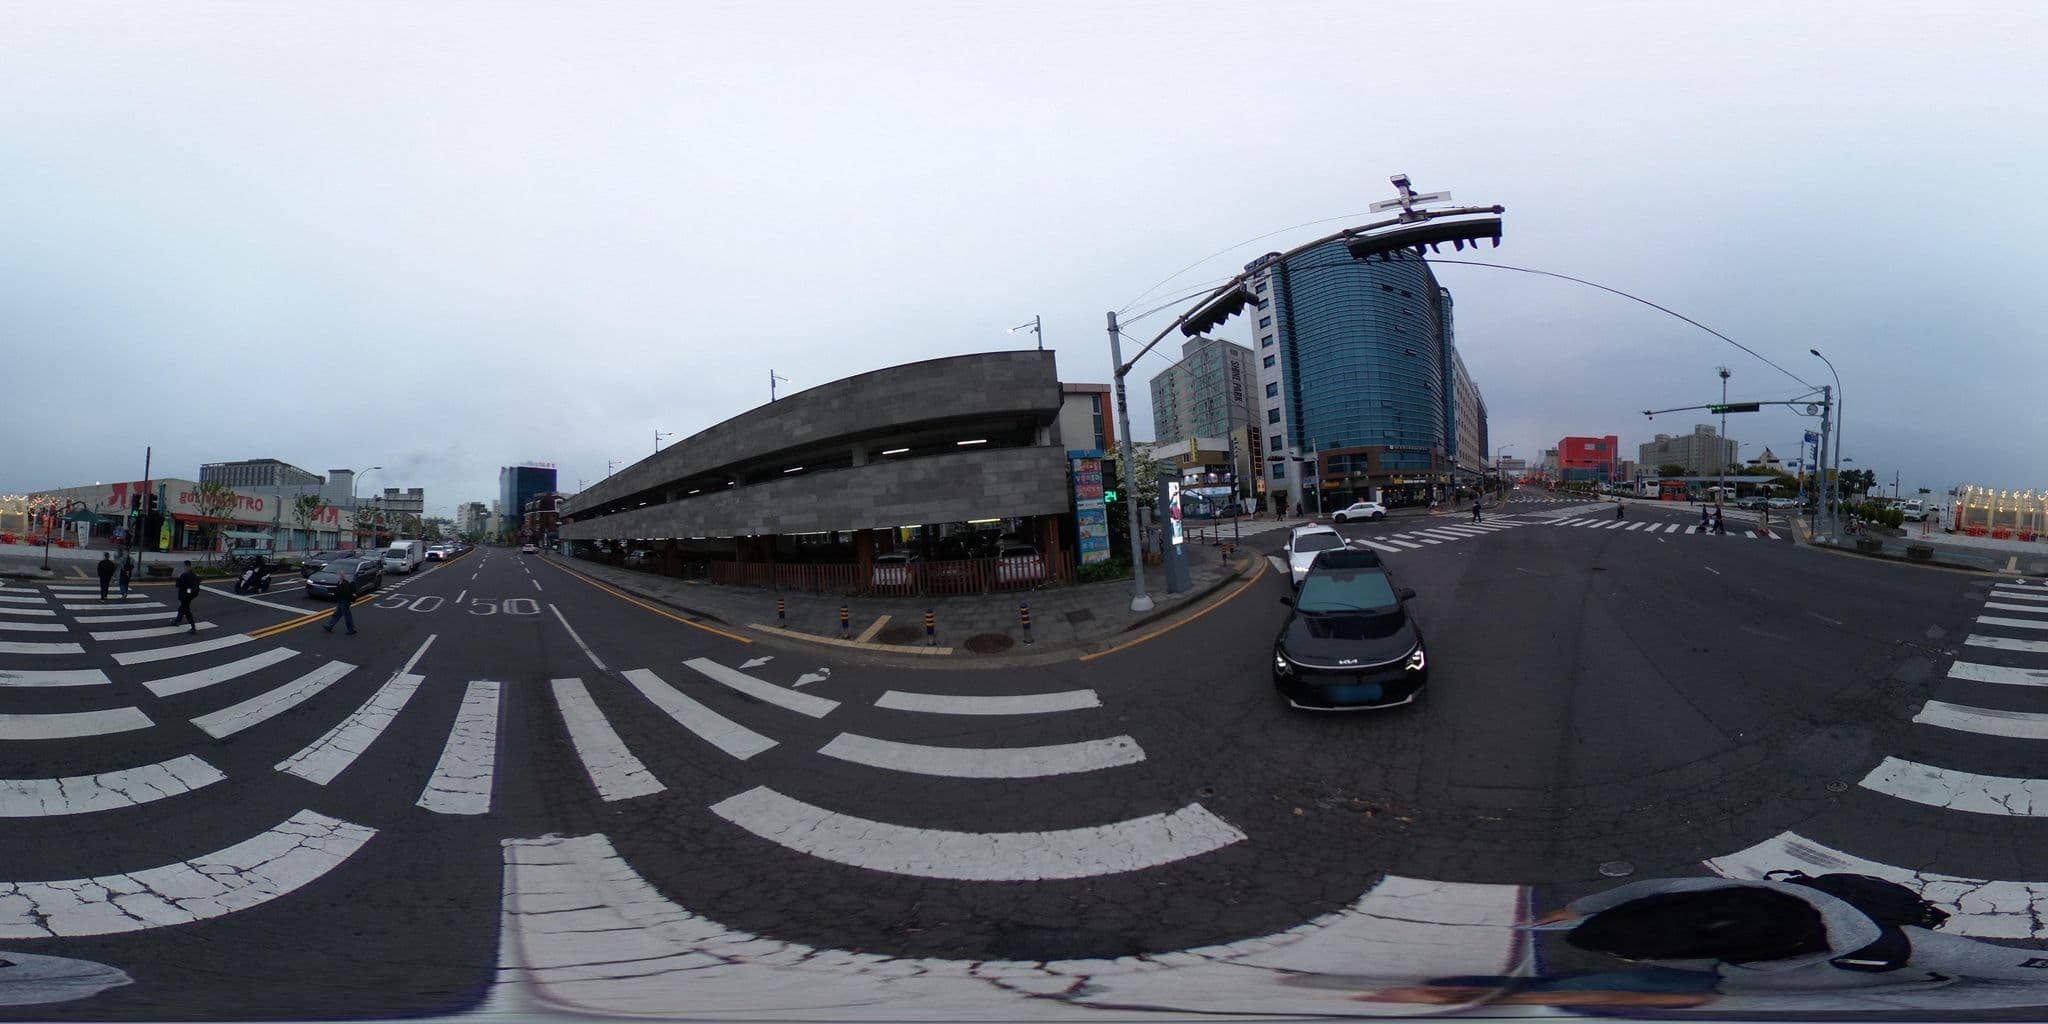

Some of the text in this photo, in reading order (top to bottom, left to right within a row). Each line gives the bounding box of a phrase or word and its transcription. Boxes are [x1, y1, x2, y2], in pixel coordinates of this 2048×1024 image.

[1231, 360, 1241, 381] SHINE
[1233, 382, 1243, 401] PARK
[1104, 490, 1117, 503] 24
[374, 593, 444, 613] 50
[469, 598, 541, 616] 50
